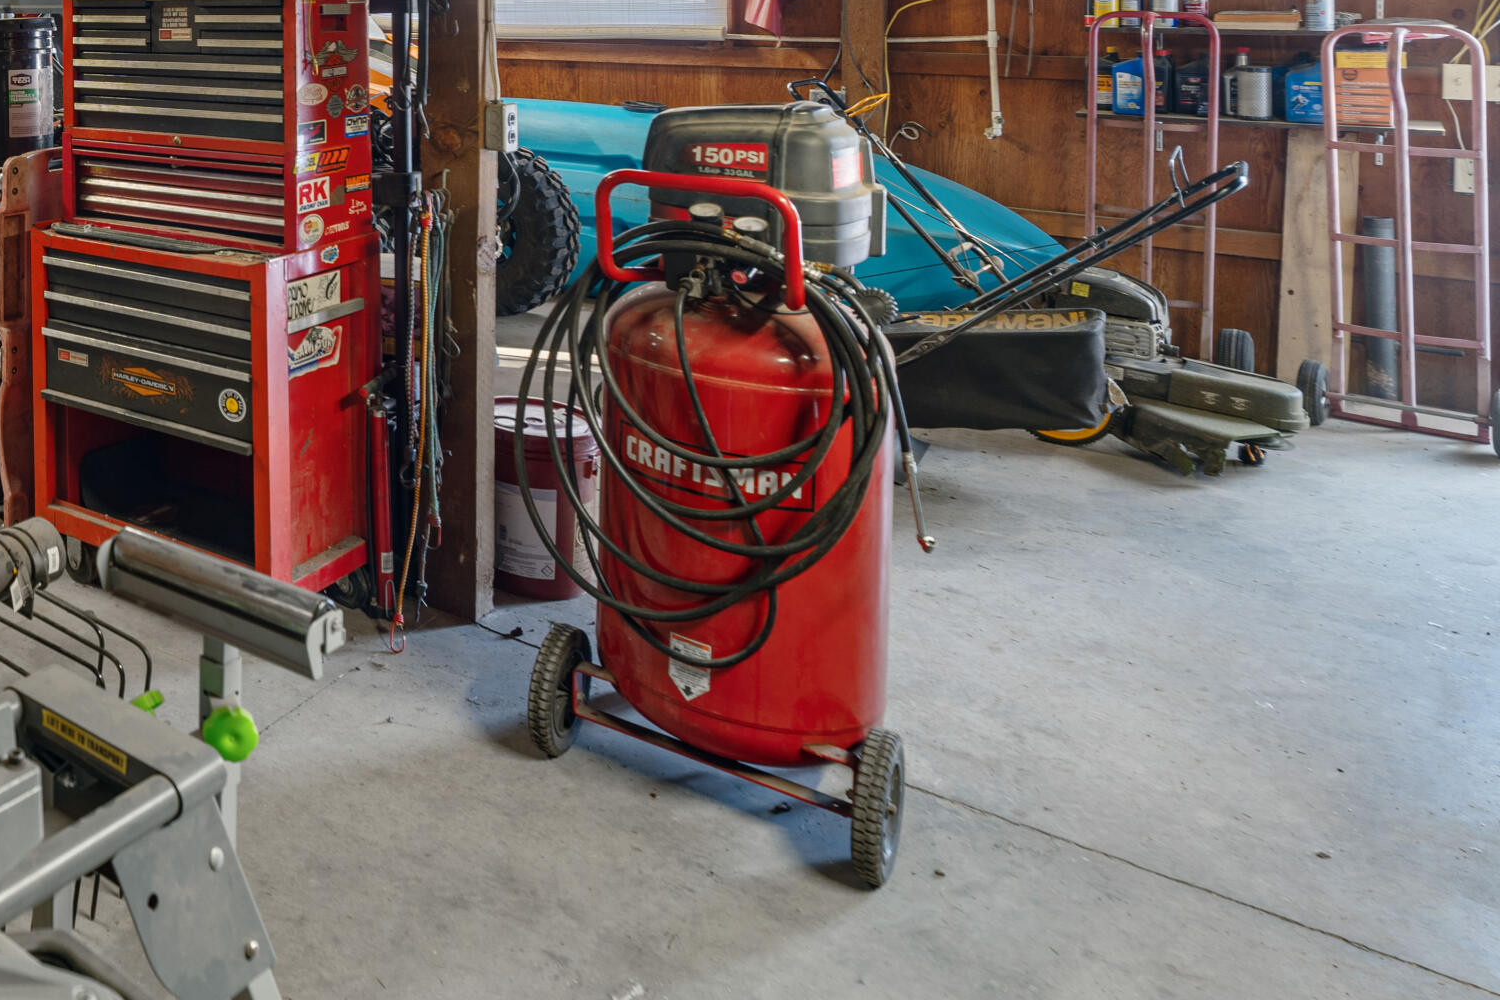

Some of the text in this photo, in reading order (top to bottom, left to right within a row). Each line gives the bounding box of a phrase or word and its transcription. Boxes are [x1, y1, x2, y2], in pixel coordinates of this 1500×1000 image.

[691, 146, 765, 165] 150 PSI
[299, 180, 328, 205] RK
